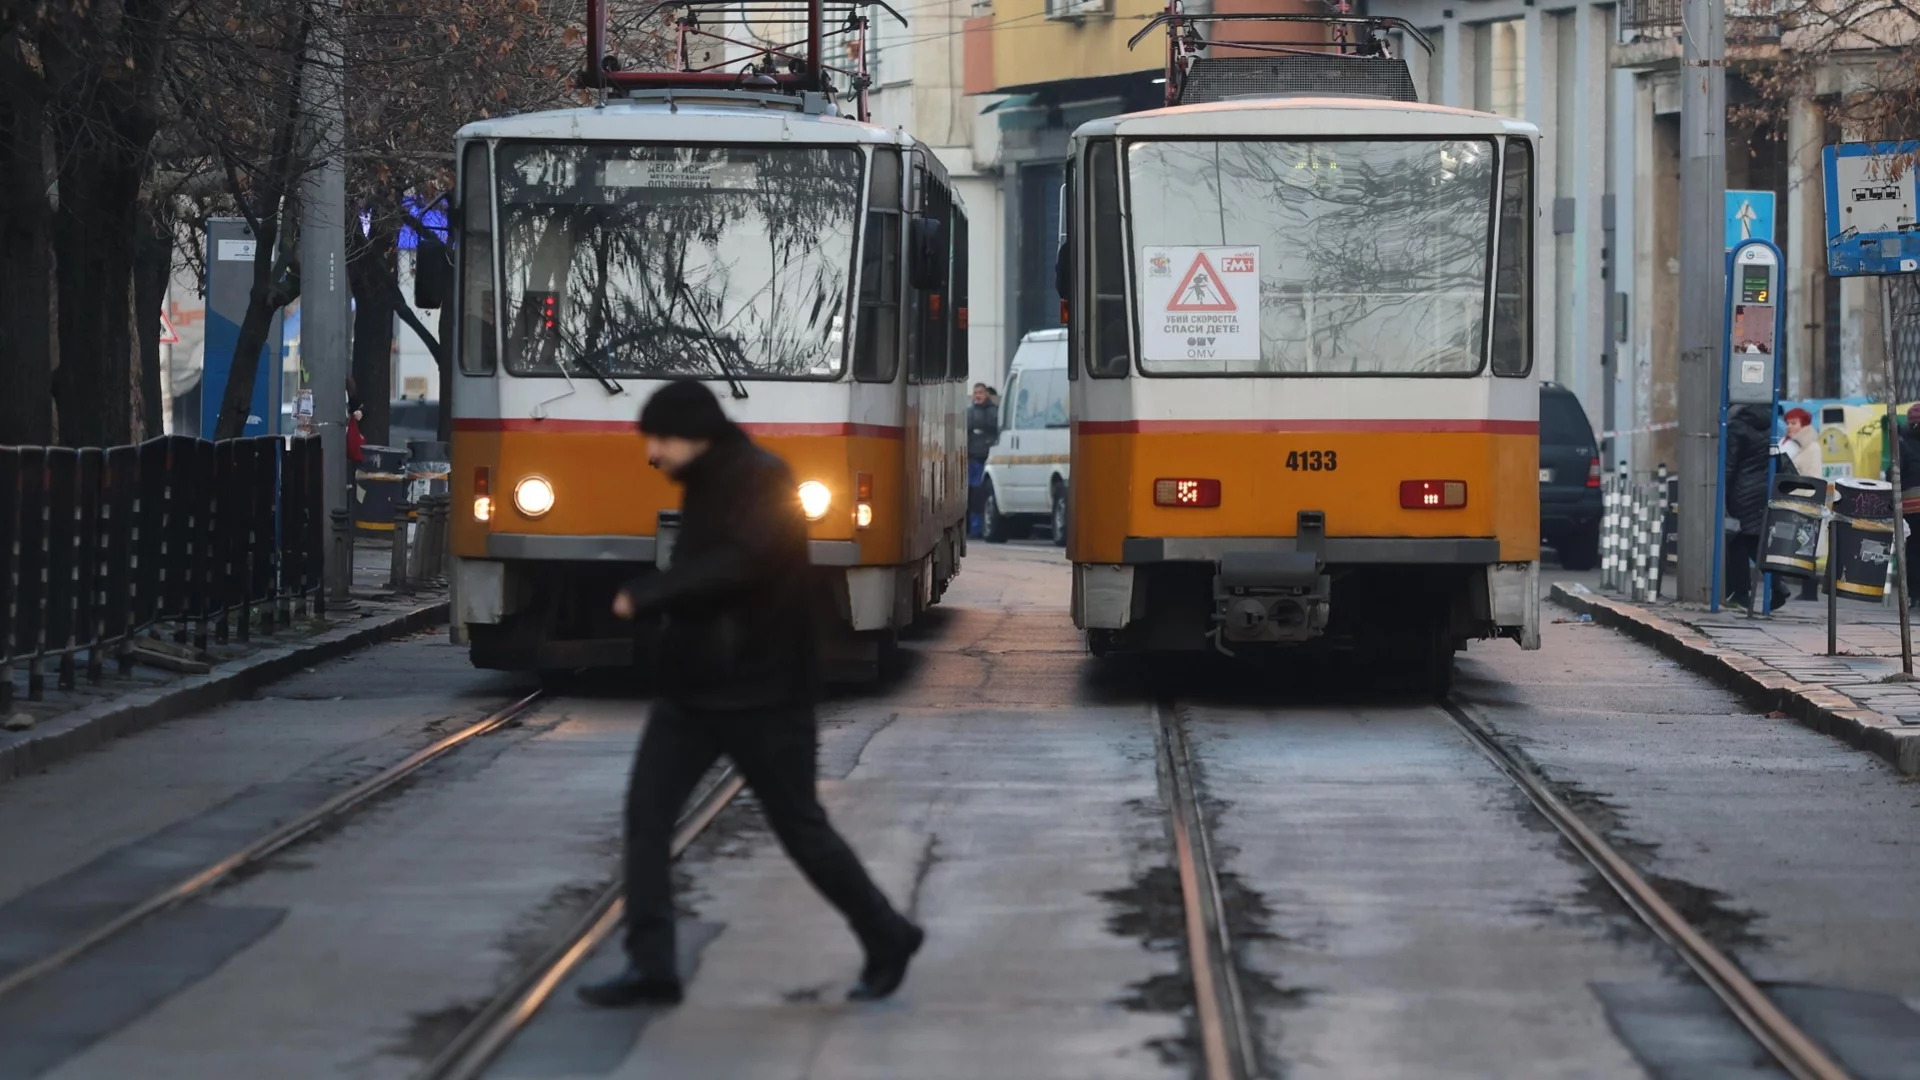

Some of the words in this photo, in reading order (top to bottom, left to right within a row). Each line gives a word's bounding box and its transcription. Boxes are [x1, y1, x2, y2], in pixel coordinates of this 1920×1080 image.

[647, 163, 674, 173] ДЕПО
[1222, 258, 1253, 272] FM+
[1758, 291, 1767, 302] 2
[1166, 315, 1188, 323] УБИЙ
[1191, 315, 1237, 323] СКОРОСТТА
[1164, 325, 1203, 333] СПАСИ
[1206, 325, 1239, 334] ДЕТЕ!
[1187, 349, 1216, 358] OMV
[1285, 450, 1337, 471] 4133
